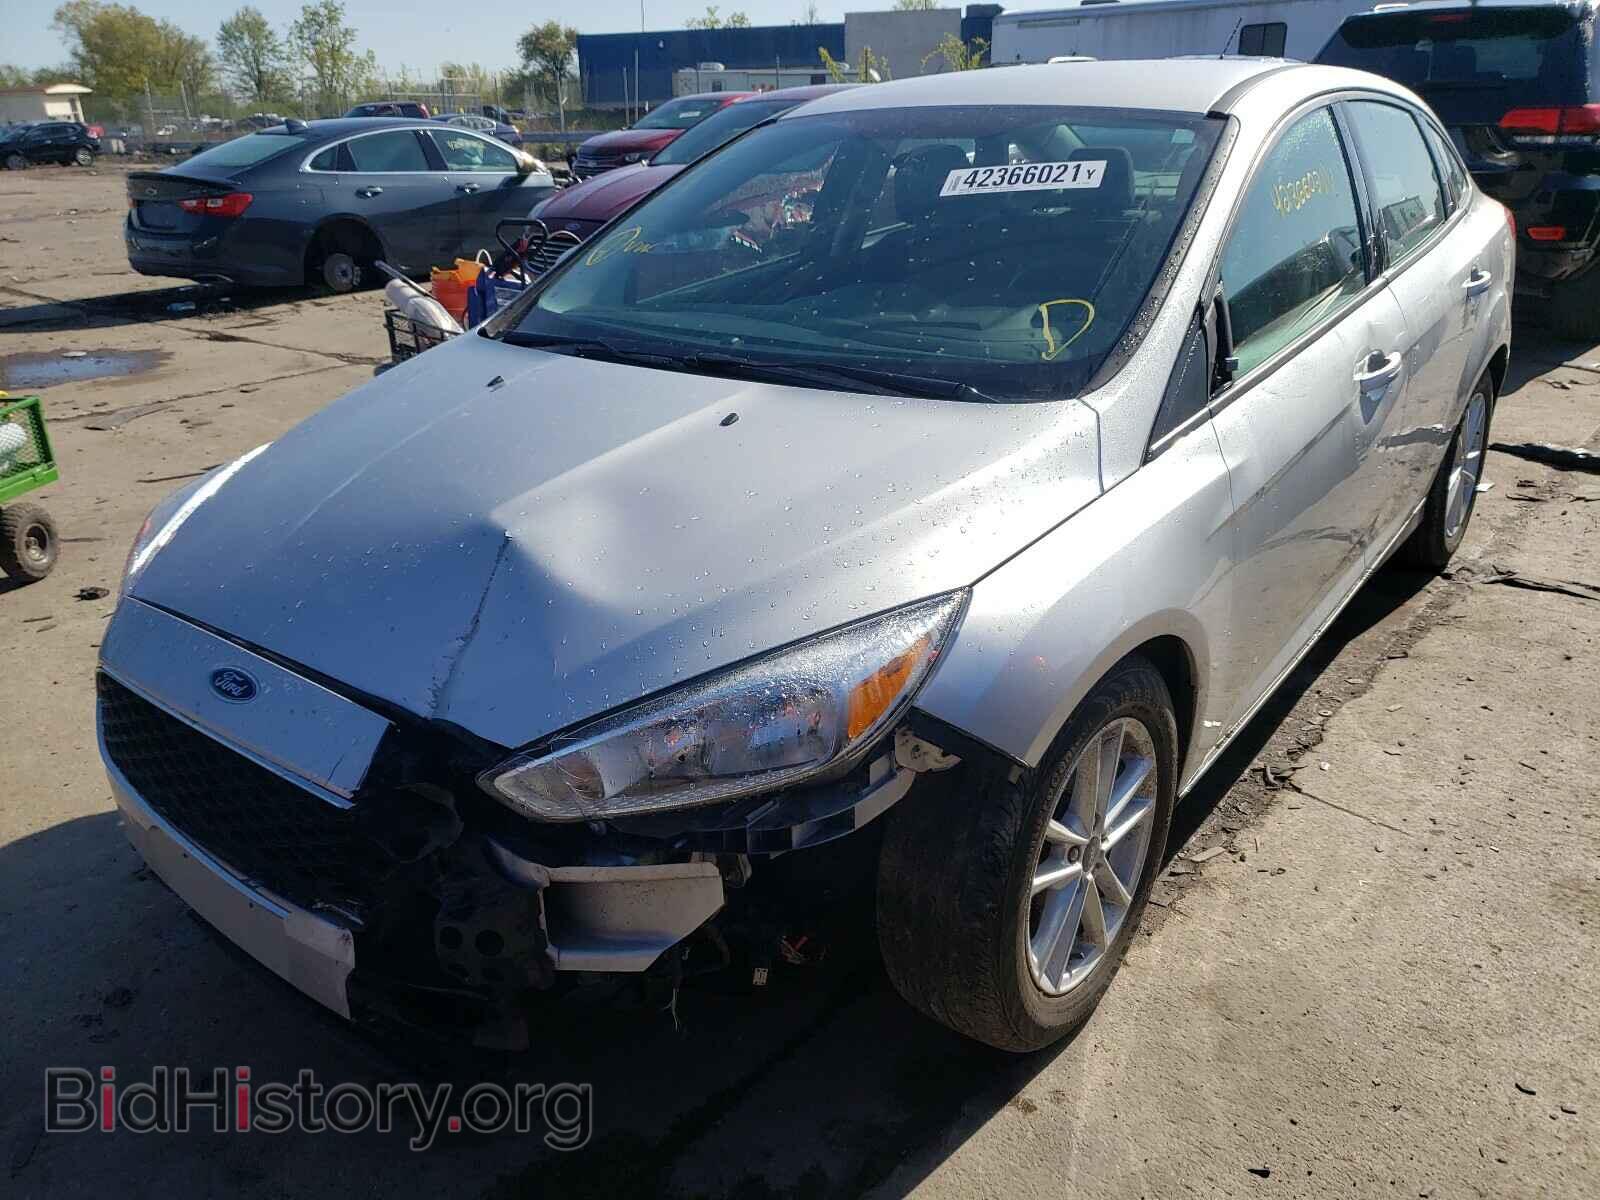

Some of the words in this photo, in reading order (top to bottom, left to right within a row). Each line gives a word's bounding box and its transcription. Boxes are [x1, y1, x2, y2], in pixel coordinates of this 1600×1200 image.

[963, 163, 1083, 188] 42366021
[1086, 168, 1097, 180] Y
[1038, 298, 1095, 361] D
[214, 671, 250, 698] Ford
